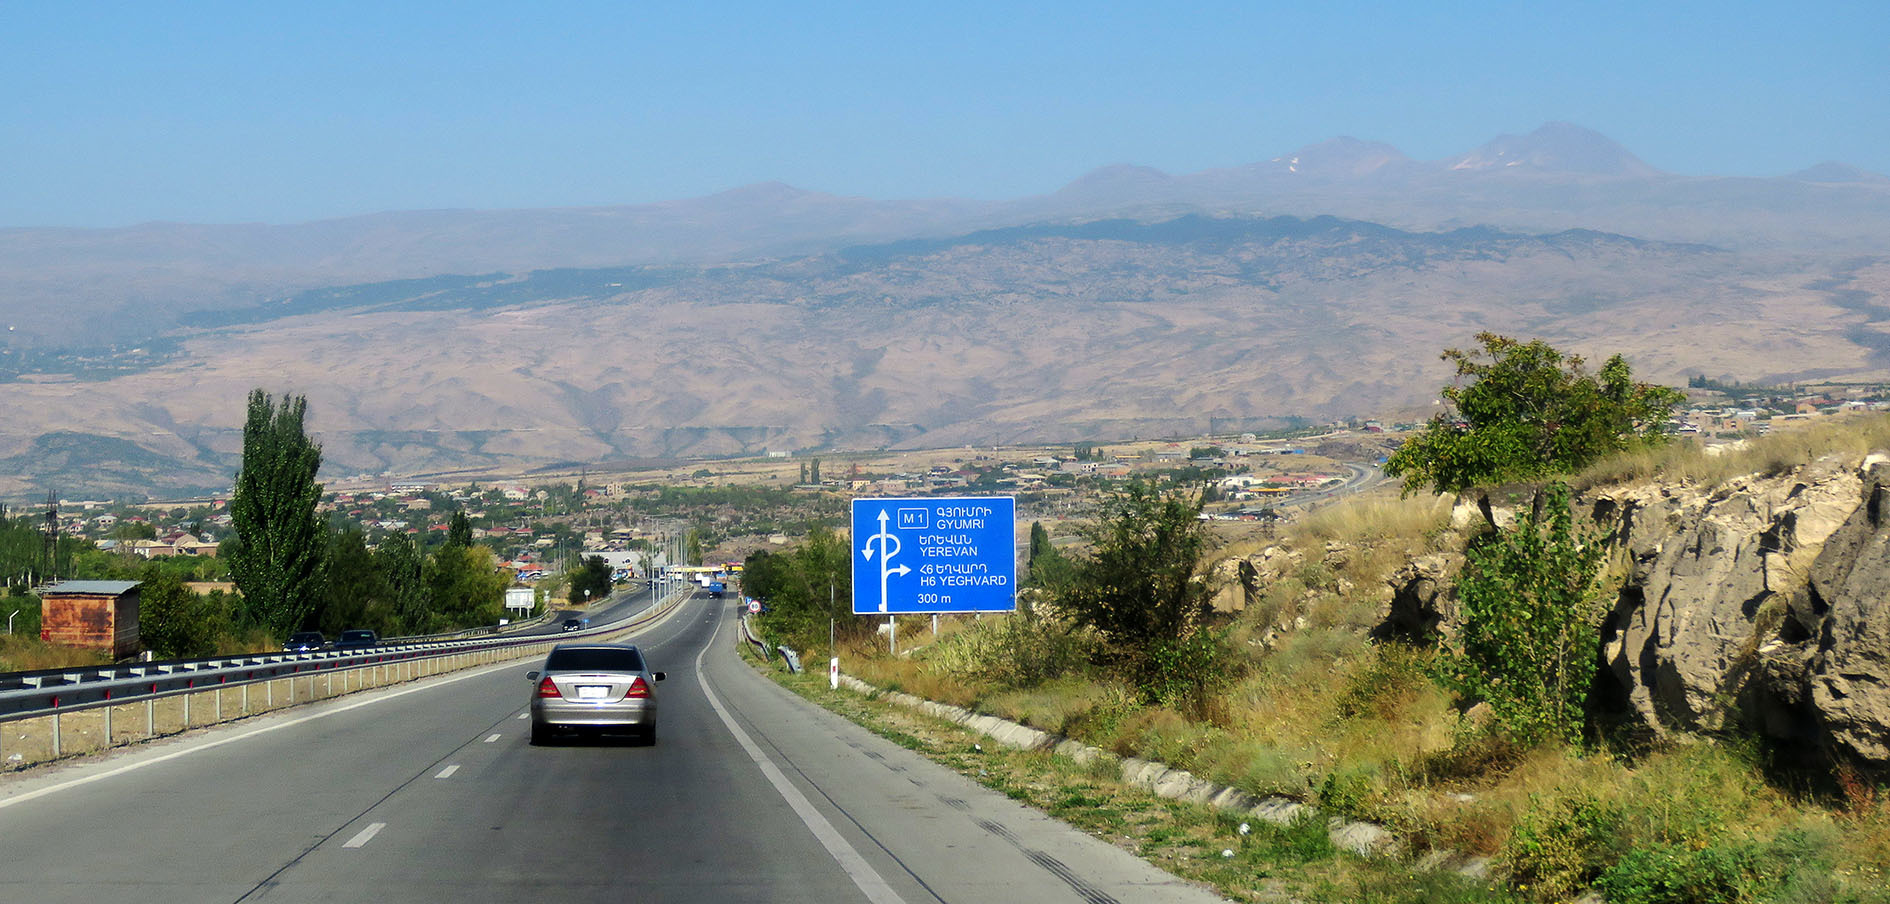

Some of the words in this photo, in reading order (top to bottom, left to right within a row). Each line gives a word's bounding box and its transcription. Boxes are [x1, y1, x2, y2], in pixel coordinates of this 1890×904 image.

[936, 507, 992, 518] ԳՅՈՒՄՐԻ
[904, 514, 914, 524] M
[918, 514, 923, 524] 1
[936, 520, 984, 530] GYUMRI
[920, 535, 972, 545] ԵՐԵՎԱՆ
[920, 546, 978, 557] YEREVAN
[936, 564, 988, 575] ԵՂՎԱՐԴ
[920, 576, 936, 586] H6
[940, 576, 1007, 586] YEGHVARD
[918, 594, 938, 604] 300
[940, 596, 952, 604] m
